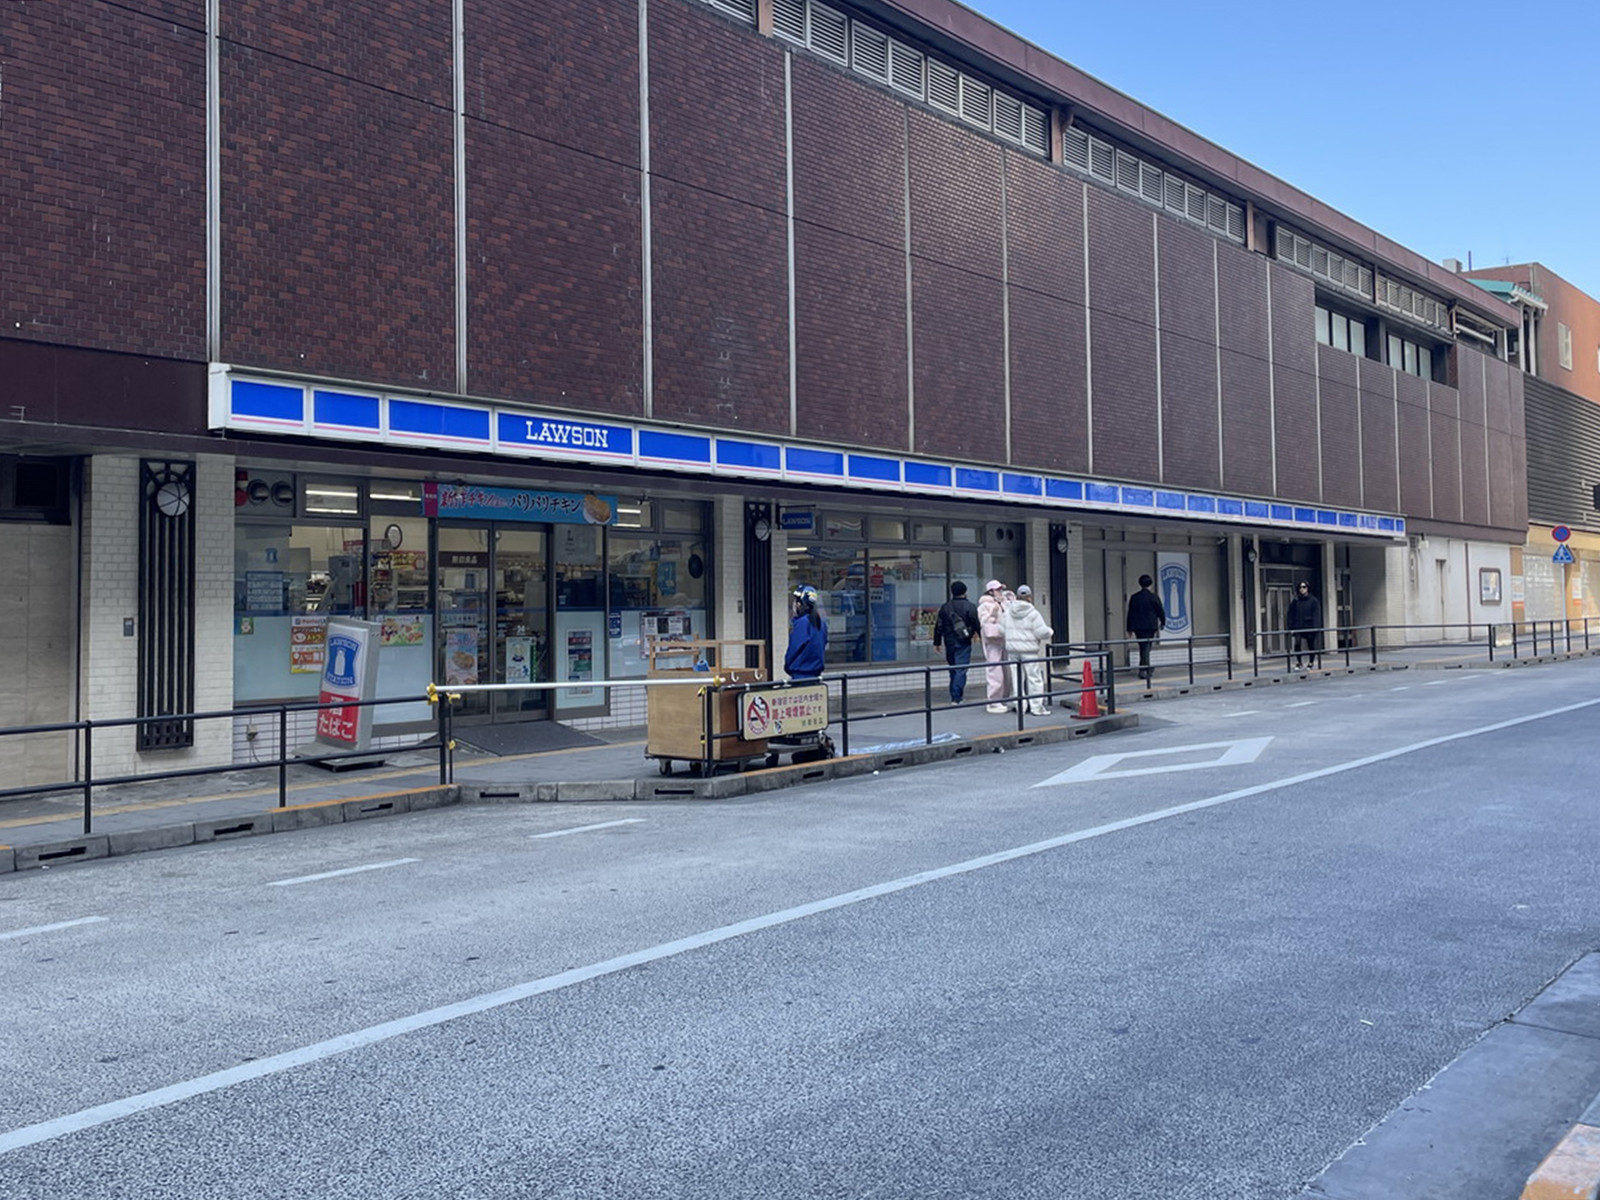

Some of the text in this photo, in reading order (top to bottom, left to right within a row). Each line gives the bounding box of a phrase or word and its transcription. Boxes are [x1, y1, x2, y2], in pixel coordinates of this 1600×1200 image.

[526, 421, 609, 448] LAWSON
[509, 493, 582, 514] パリパリチキン
[329, 637, 358, 651] LAWSON
[326, 673, 354, 686] STATION
[318, 713, 353, 740] たばこ
